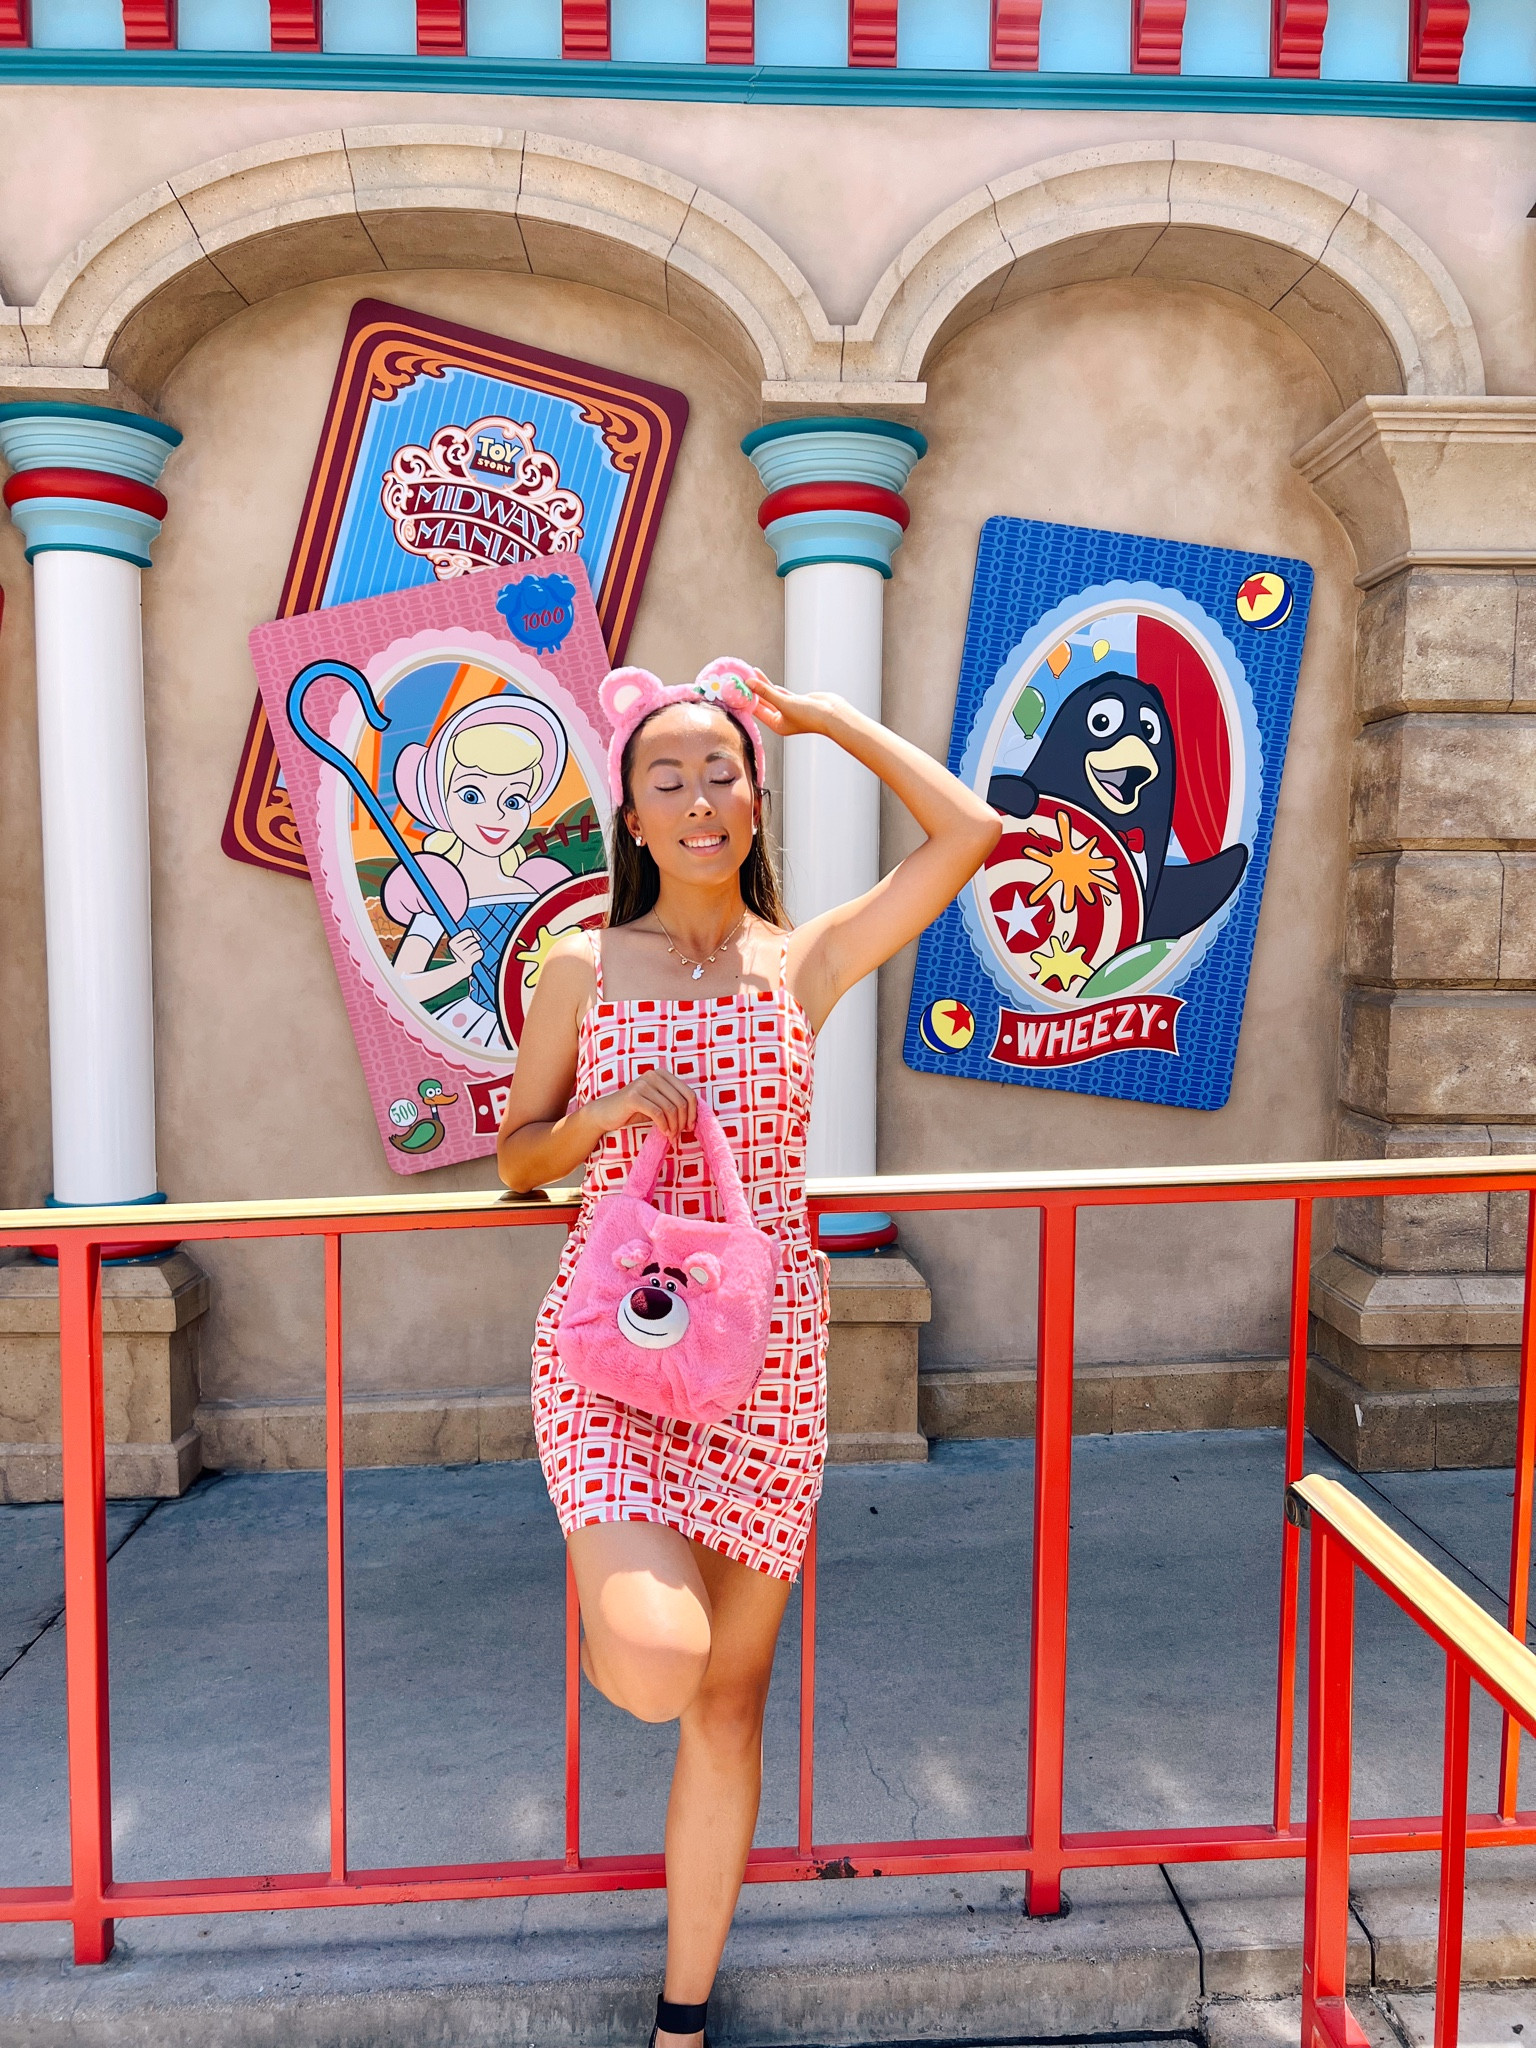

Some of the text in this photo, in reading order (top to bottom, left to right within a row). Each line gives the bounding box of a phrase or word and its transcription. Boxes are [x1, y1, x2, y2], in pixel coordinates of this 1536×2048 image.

[478, 436, 522, 463] TOY
[477, 458, 511, 473] STORY
[414, 485, 551, 546] MIDWAY
[522, 606, 564, 632] 1000
[1016, 1003, 1163, 1059] WHEEZY
[391, 1102, 417, 1123] 500
